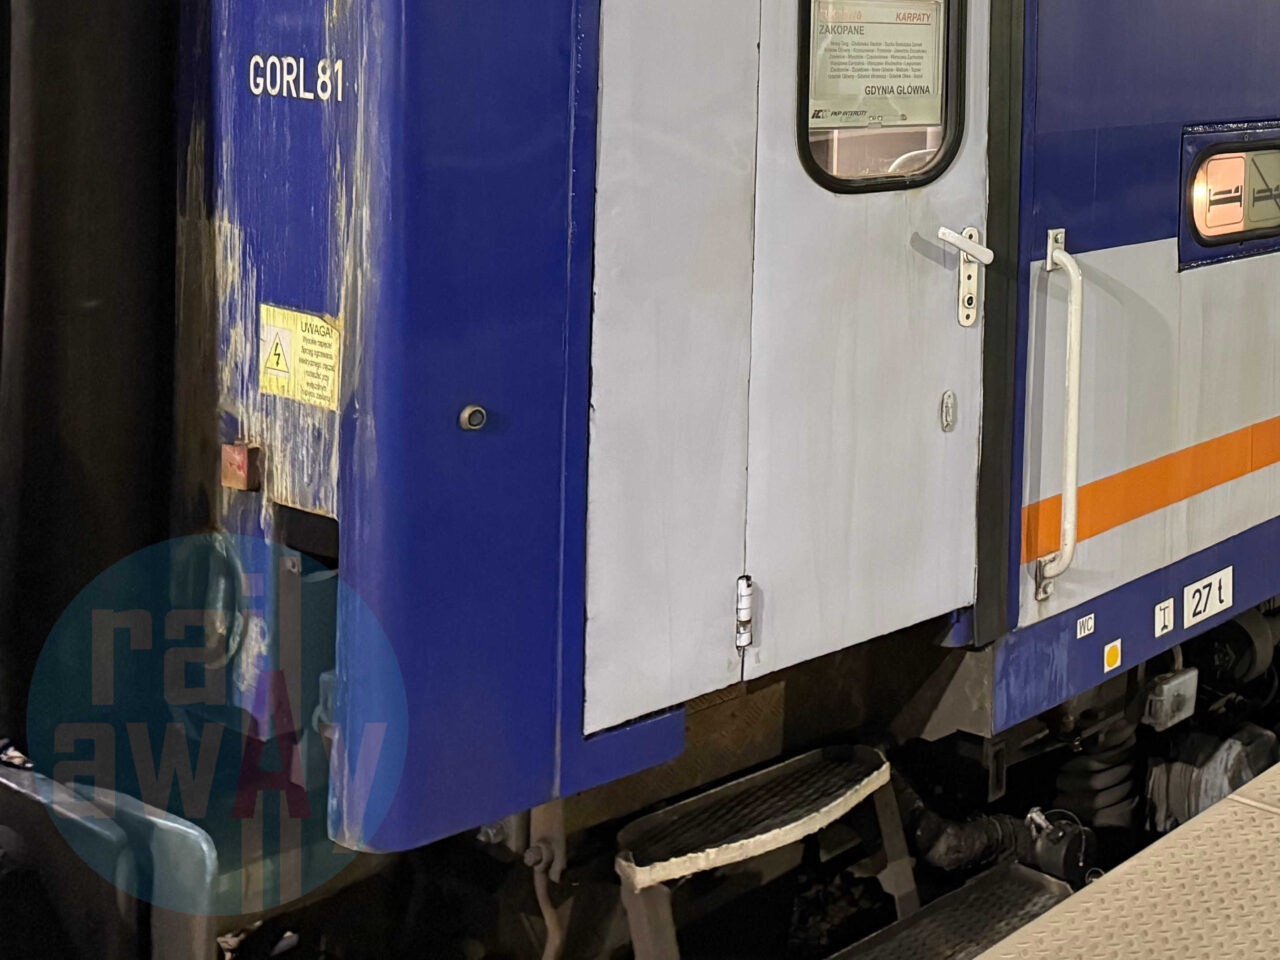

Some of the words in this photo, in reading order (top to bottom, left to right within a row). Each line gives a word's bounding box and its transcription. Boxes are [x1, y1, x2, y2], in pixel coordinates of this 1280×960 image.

[895, 12, 931, 22] KARPATY
[819, 25, 865, 35] ZAKOPANE
[865, 85, 894, 95] GDYNIA
[896, 83, 930, 95] GŁÓWNA
[301, 322, 334, 338] UWAGA!
[1192, 582, 1213, 618] 27
[1217, 578, 1225, 605] t
[1078, 617, 1093, 636] WC
